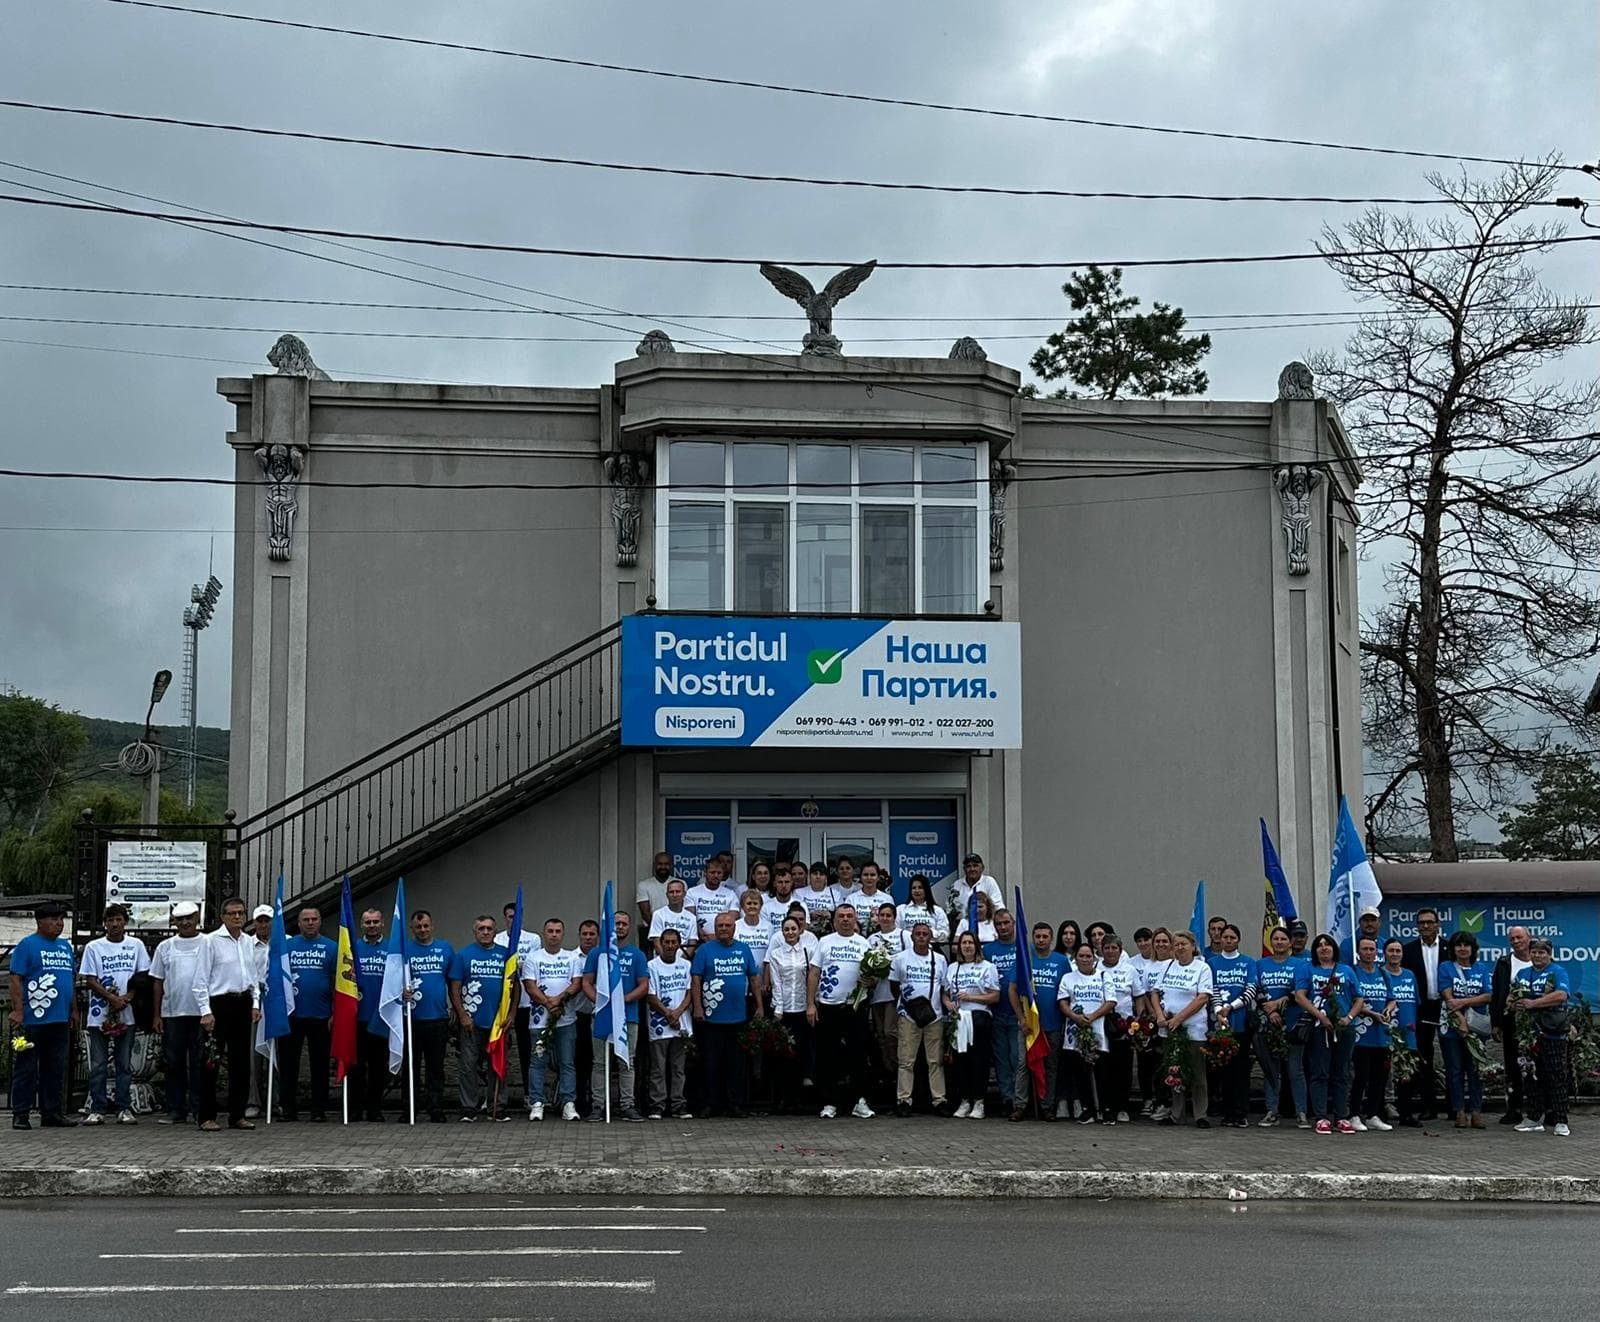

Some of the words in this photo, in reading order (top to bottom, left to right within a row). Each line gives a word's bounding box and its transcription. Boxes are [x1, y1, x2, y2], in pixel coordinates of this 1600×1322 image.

[655, 631, 787, 662] Partidul
[887, 635, 987, 664] Наша
[655, 666, 775, 697] Nostru.
[863, 669, 997, 705] Партия.
[666, 715, 736, 731] Nisporeni
[795, 716, 814, 726] 069
[815, 716, 857, 726] 990-443
[868, 718, 886, 726] 069
[888, 718, 925, 727] 991-012
[936, 718, 954, 727] 022
[955, 719, 994, 728] 027-200
[898, 853, 947, 866] Partidul
[1493, 907, 1545, 921] Наша
[290, 950, 326, 959] Partidul
[410, 954, 444, 964] Partidul
